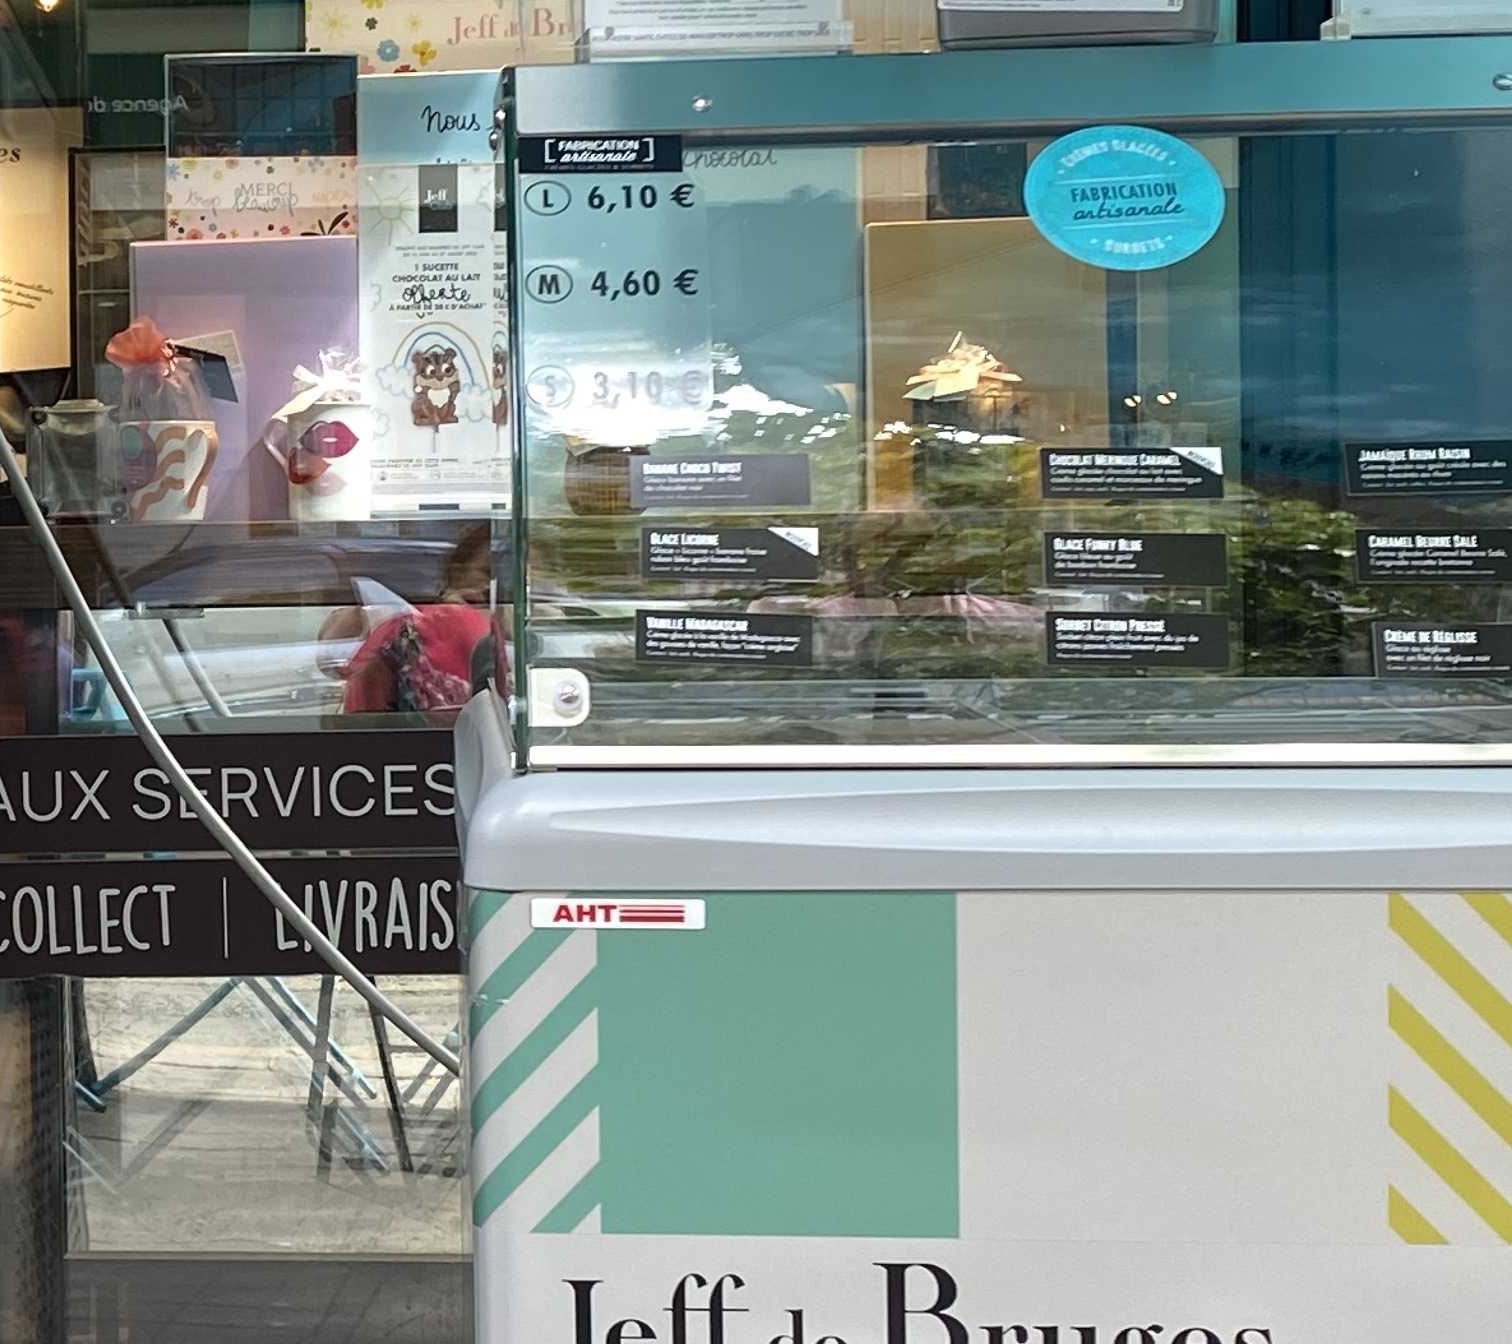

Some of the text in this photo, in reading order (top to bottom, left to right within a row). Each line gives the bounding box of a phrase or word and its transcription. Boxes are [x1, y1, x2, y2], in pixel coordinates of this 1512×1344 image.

[240, 182, 294, 197] MERCI
[587, 184, 658, 214] 6,10
[670, 182, 696, 209] €
[1070, 181, 1178, 203] FABRICATION
[1073, 197, 1185, 221] artisanale
[392, 272, 481, 282] CHOCOLAT AU LAIT
[422, 262, 459, 272] SUCETTE
[590, 269, 661, 302] 4,60
[673, 268, 700, 296] €
[592, 370, 663, 406] 3,10
[274, 876, 455, 953] LIVRAIS
[552, 904, 618, 922] AHT
